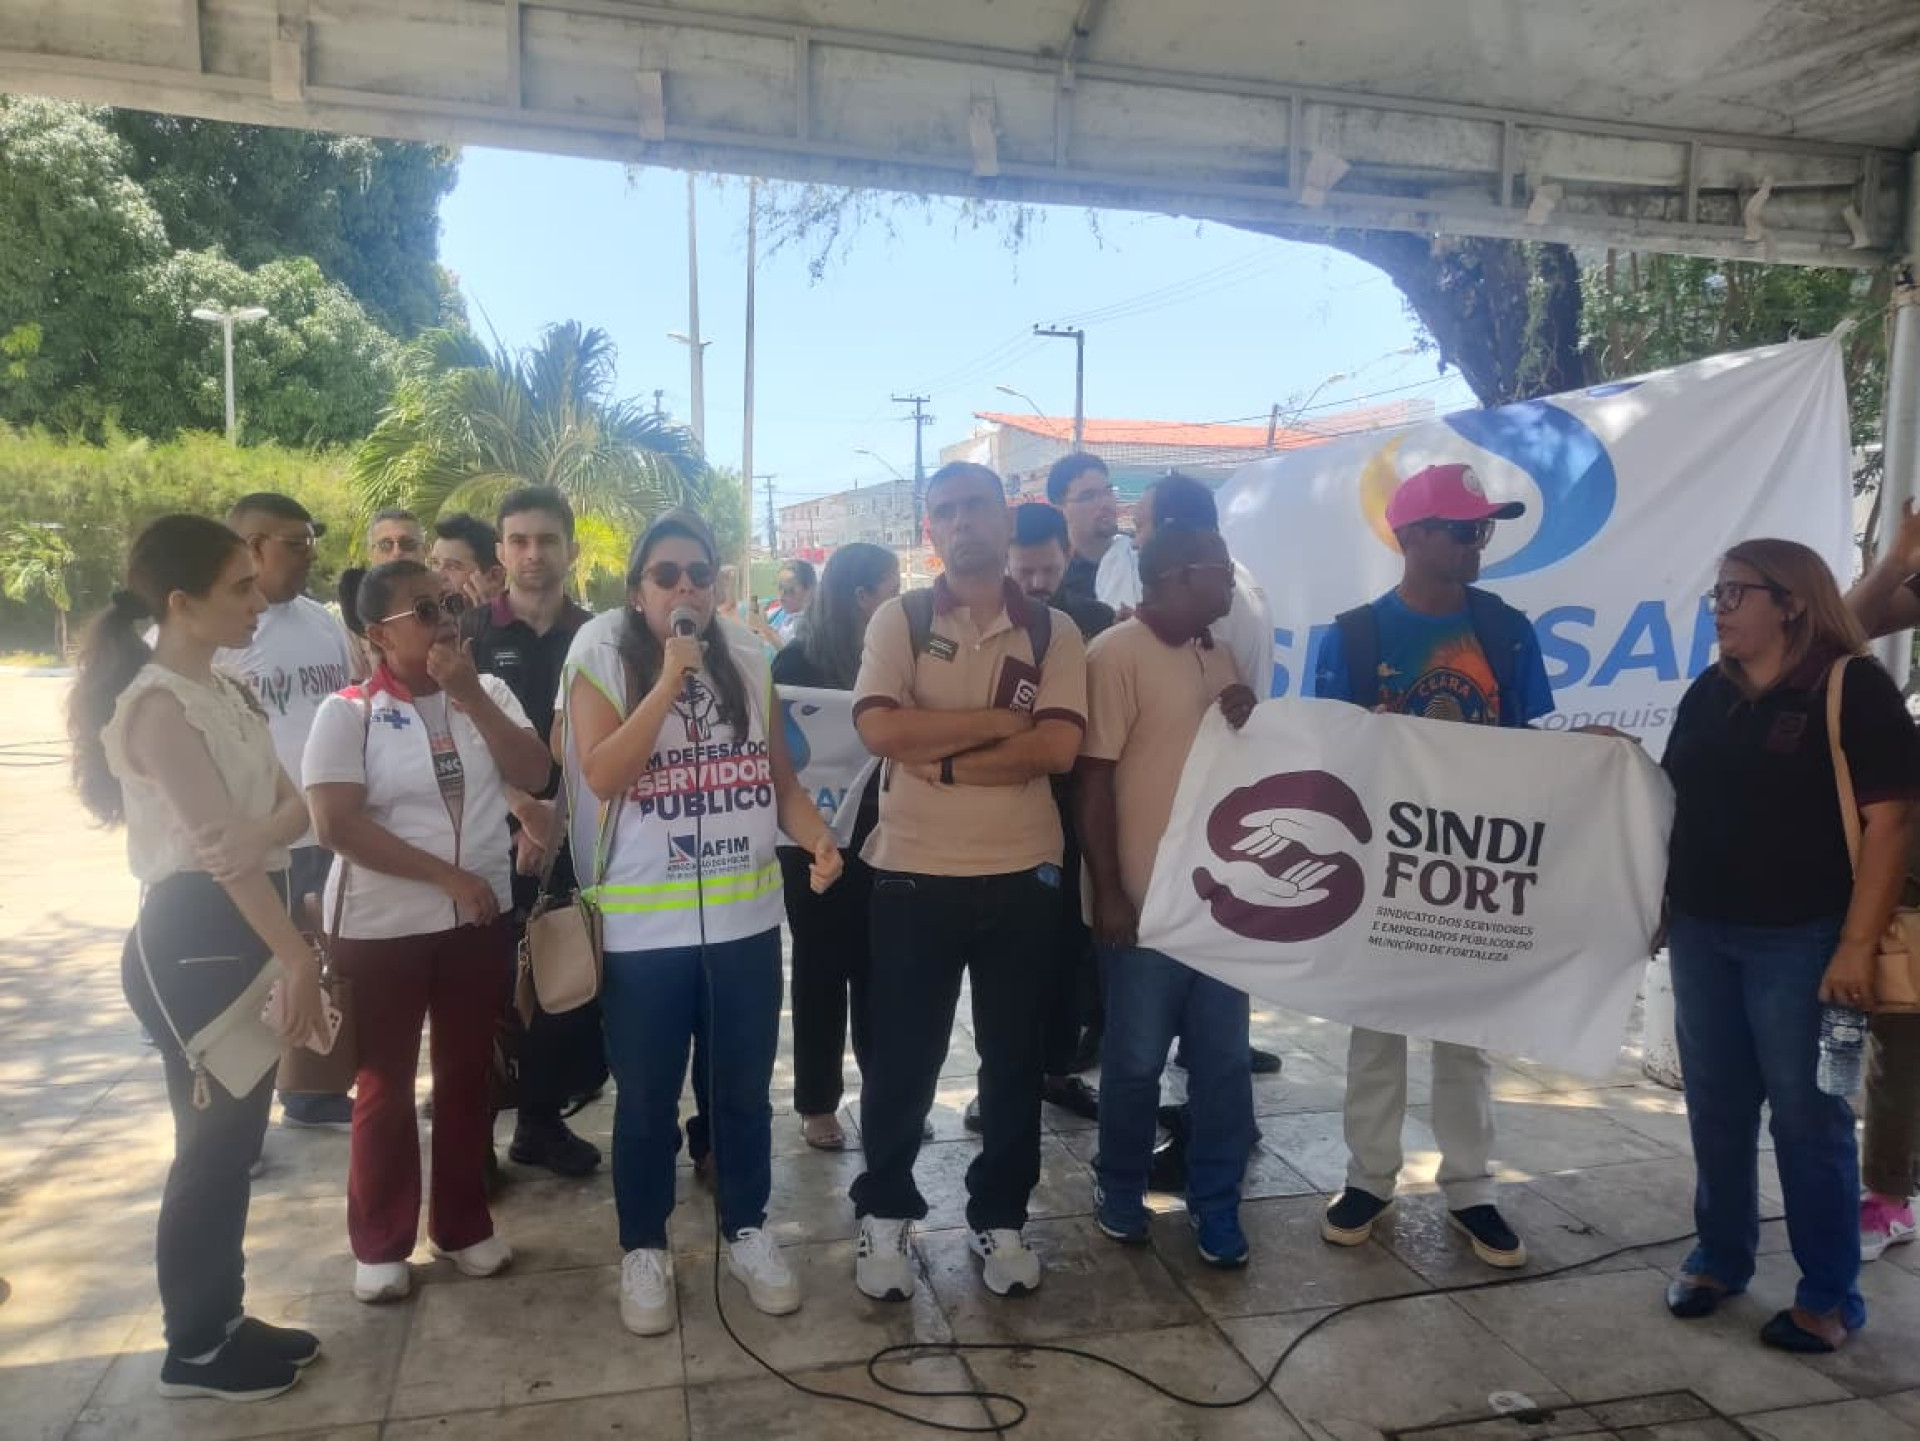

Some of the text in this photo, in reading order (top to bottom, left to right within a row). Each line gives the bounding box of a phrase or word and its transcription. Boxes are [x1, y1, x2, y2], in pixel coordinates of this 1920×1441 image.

[646, 751, 662, 770] M
[667, 742, 743, 765] DEFESA
[636, 759, 770, 797] SERVIDOR
[702, 836, 750, 858] AFIM
[1386, 801, 1546, 867] SINDI
[1382, 851, 1538, 915] FORT
[1373, 920, 1381, 931] E
[1382, 922, 1458, 942] EMPREGADOS
[1516, 940, 1534, 950] DO
[1376, 906, 1534, 936] SINDICATO DOS SERVIDORES
[1368, 935, 1509, 962] MUNICÍPIO DE FORTALEZA
